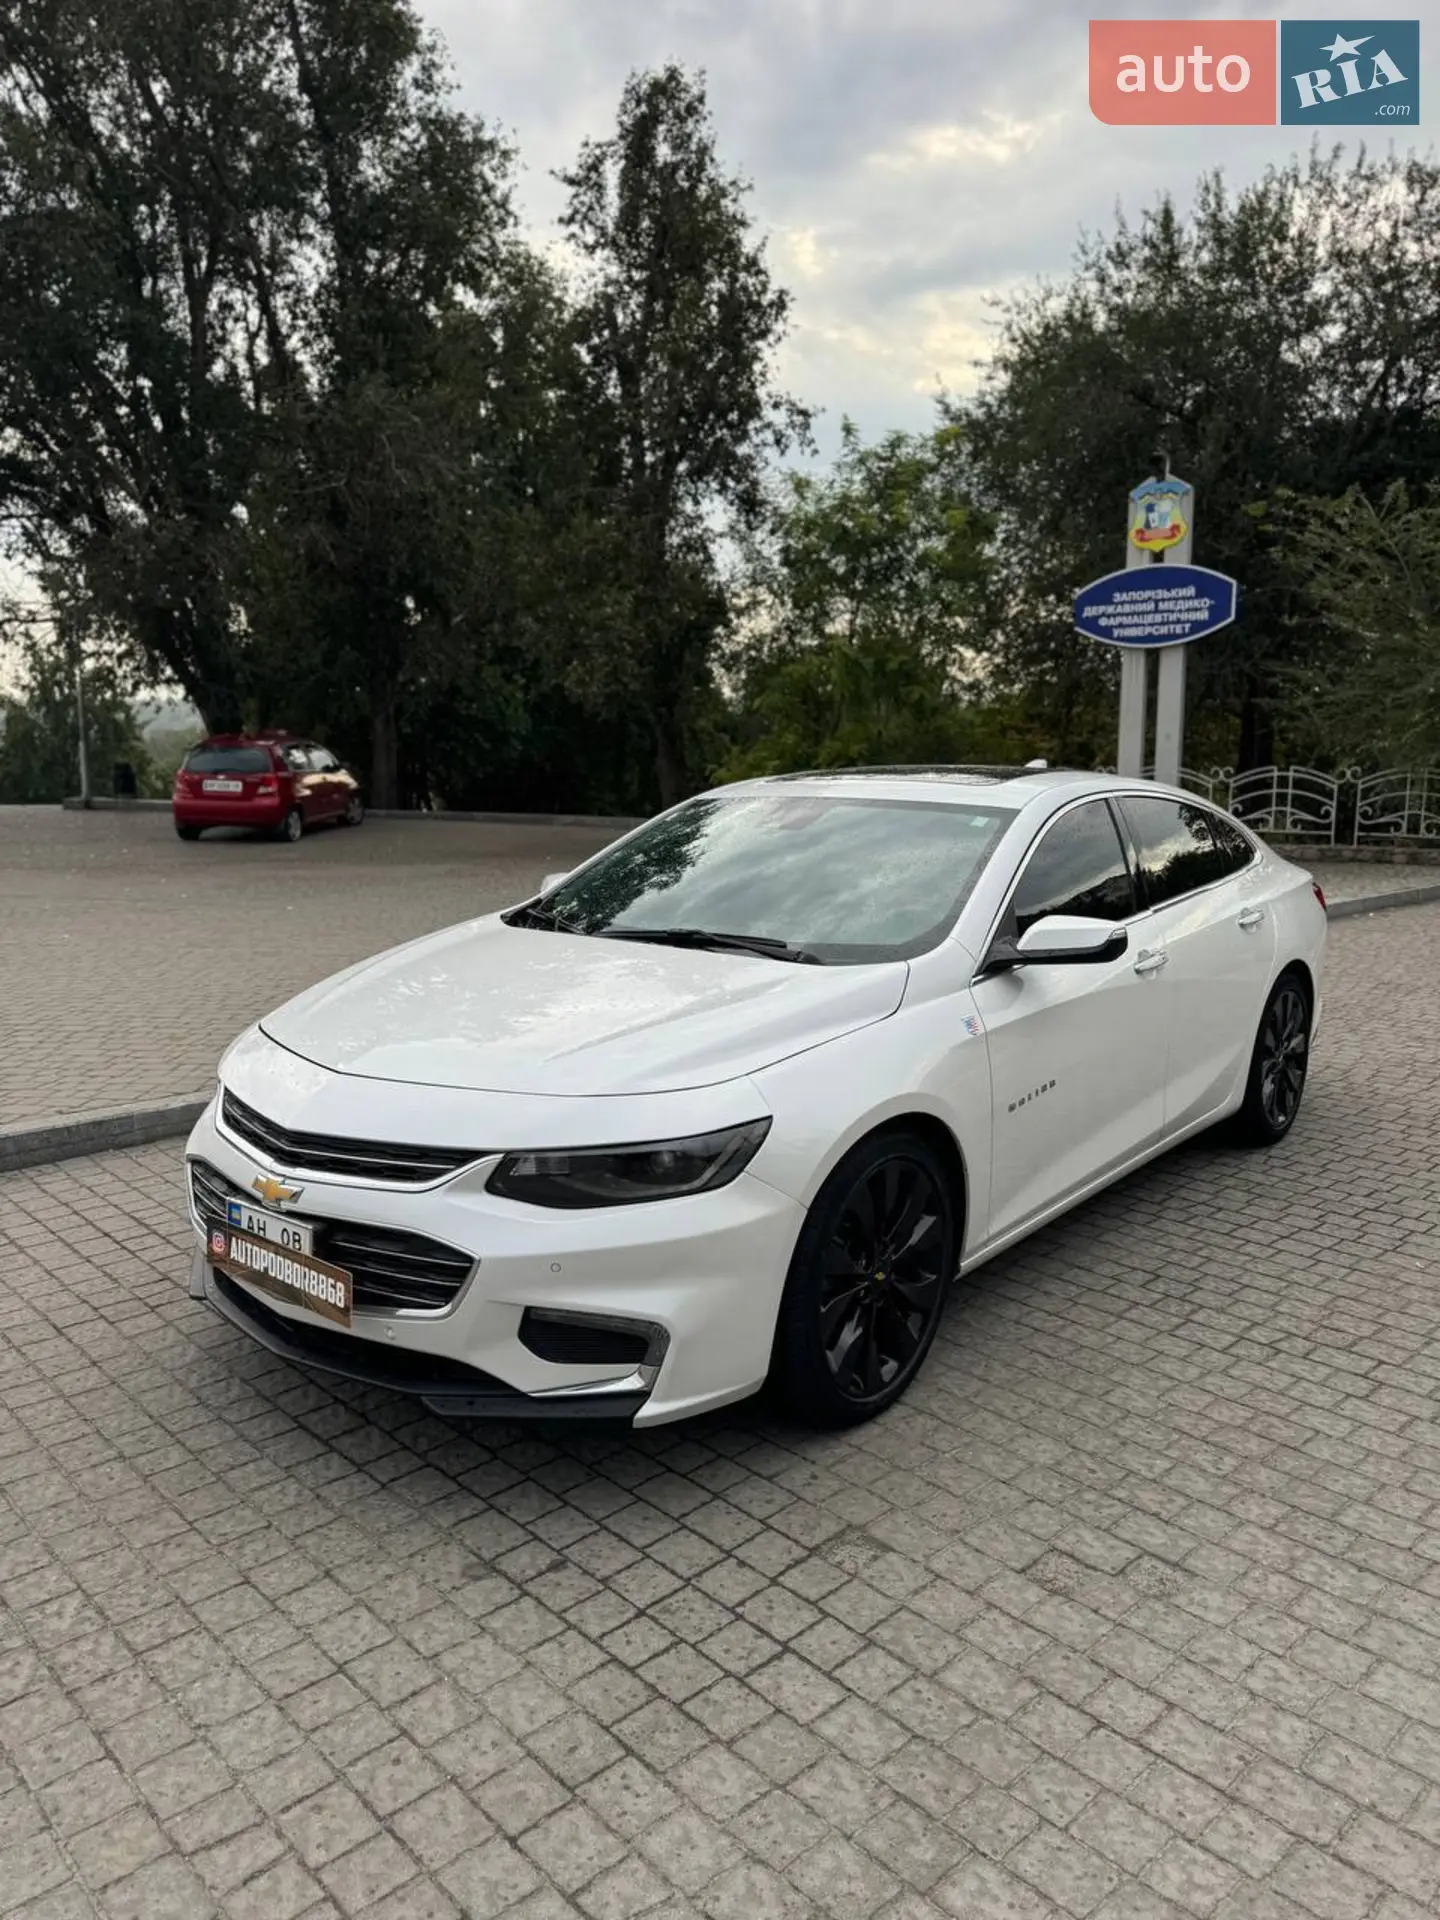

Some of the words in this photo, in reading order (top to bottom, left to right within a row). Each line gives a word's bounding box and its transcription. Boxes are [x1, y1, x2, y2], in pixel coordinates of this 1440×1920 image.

[1112, 585, 1196, 603] ЗАПОРІЗЬКИЙ
[1082, 601, 1155, 619] ДЕРЖАВНИЙ
[1157, 597, 1216, 612] МЕДИКО-
[1098, 609, 1209, 627] ФАРМАЦЕВТИЧНИЙ
[1112, 623, 1191, 638] УНІВЕРСИТЕТ
